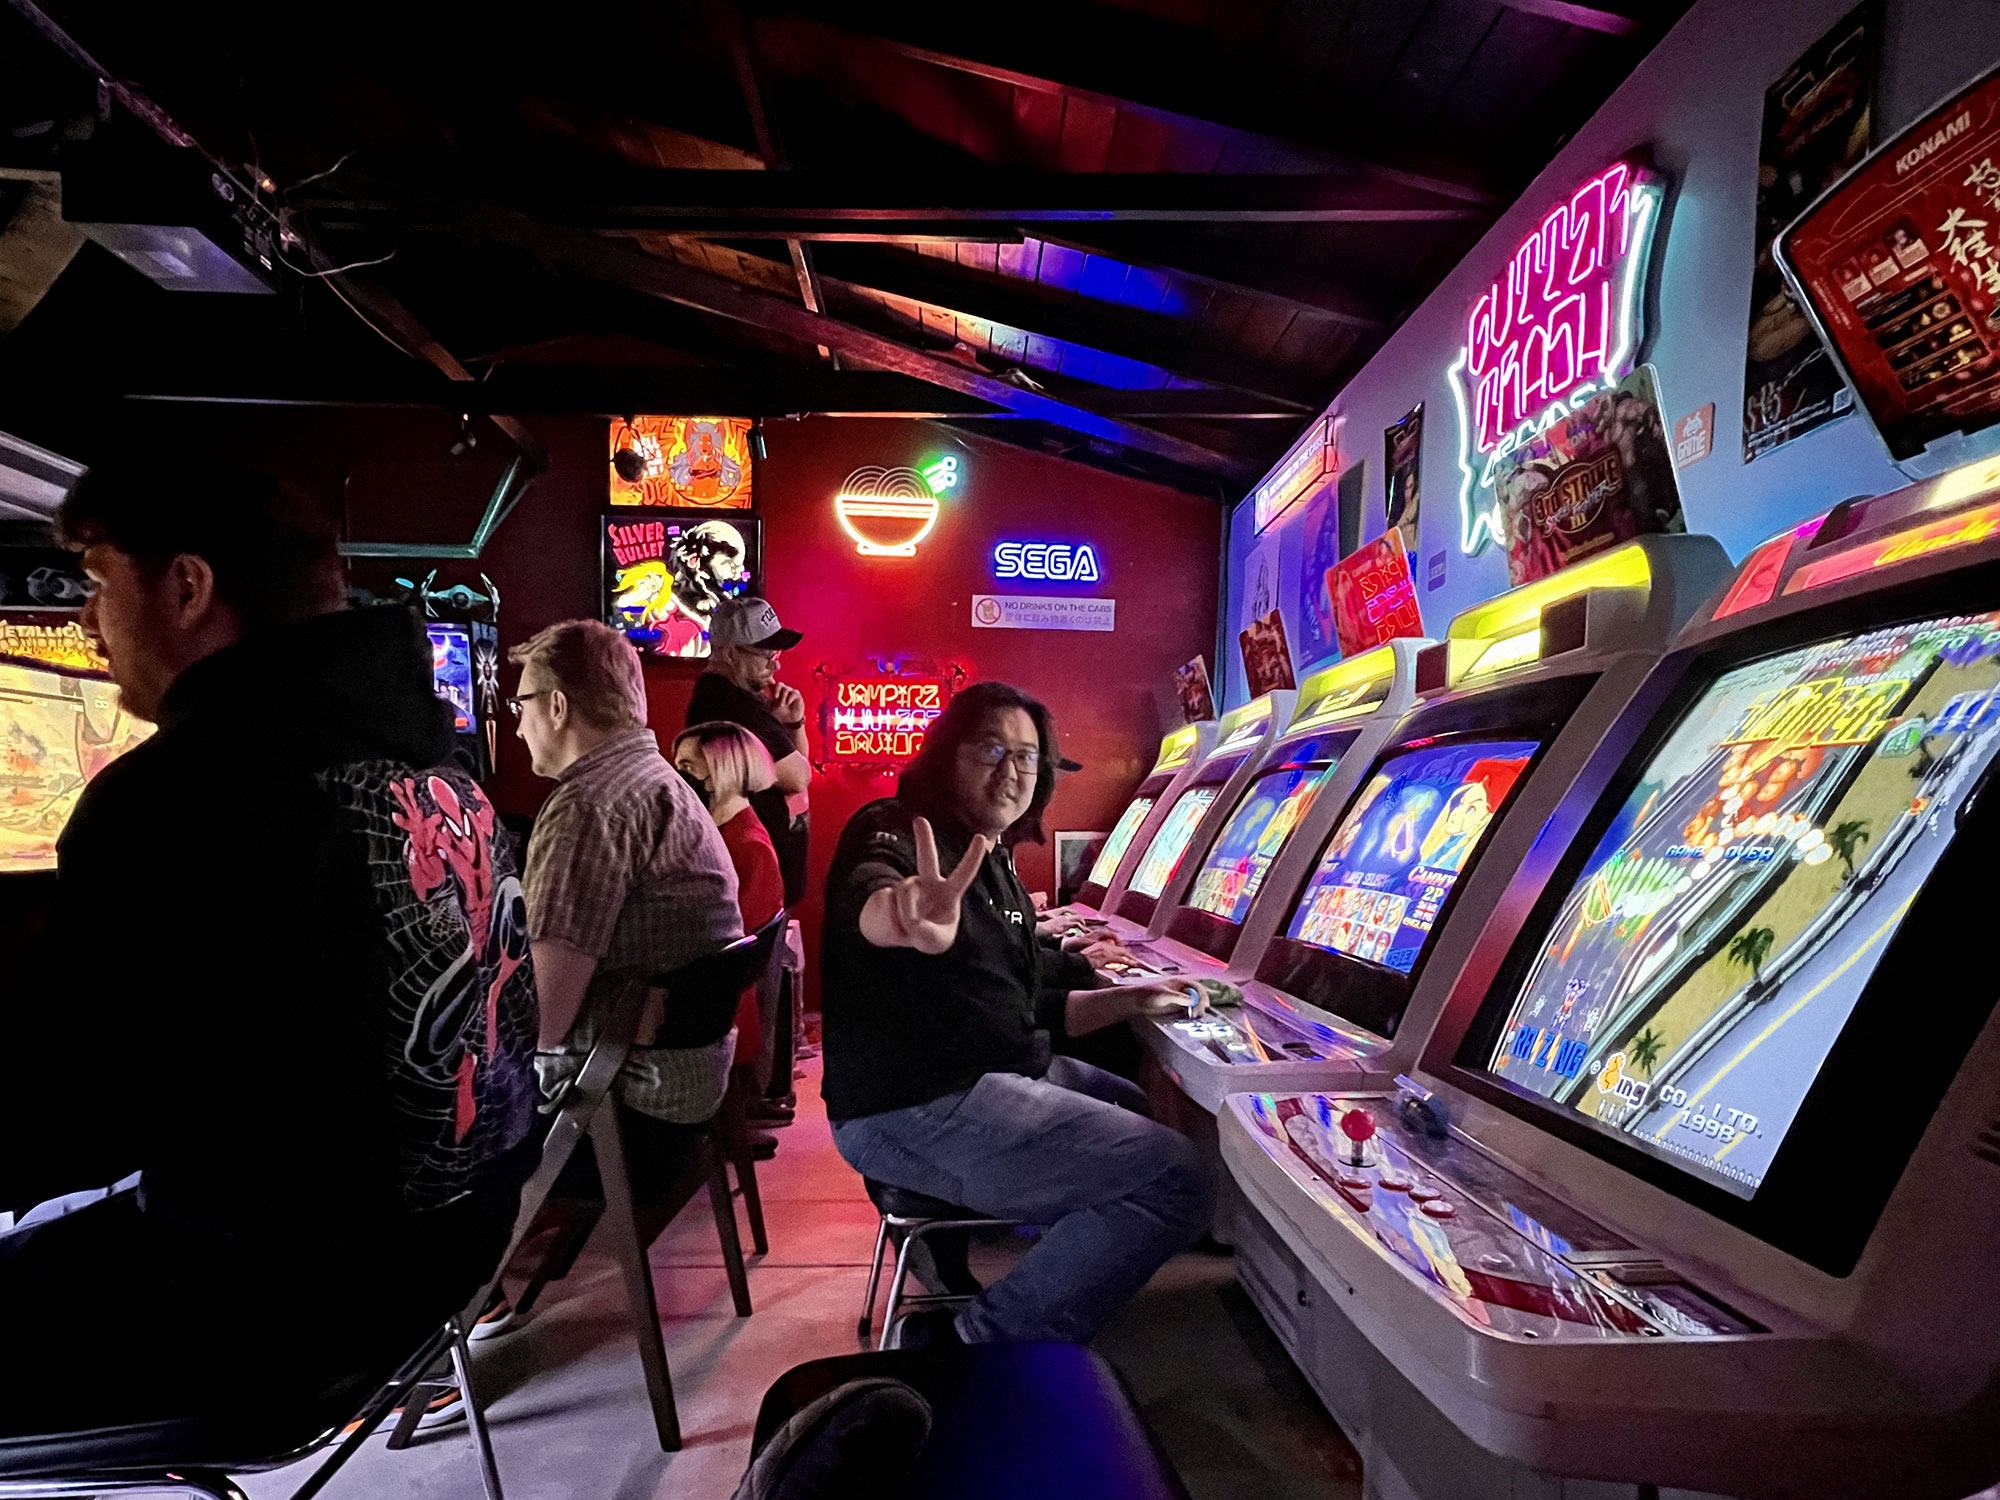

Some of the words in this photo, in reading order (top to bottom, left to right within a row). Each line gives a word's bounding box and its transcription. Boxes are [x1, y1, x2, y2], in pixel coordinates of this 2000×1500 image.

[1896, 111, 1970, 174] KONAMI
[1468, 164, 1629, 376] GUTTER
[1476, 281, 1609, 453] TRASH
[608, 522, 664, 546] SILVER
[613, 541, 665, 566] BULLET
[995, 542, 1098, 581] SEGA
[1005, 602, 1018, 610] NO
[1020, 602, 1052, 611] DRINKS
[1054, 603, 1067, 611] ON
[1070, 604, 1086, 612] THE
[1088, 604, 1112, 613] CABS
[1665, 844, 1704, 858] GAME
[1724, 846, 1775, 861] OVER
[1421, 885, 1445, 903] 2P
[1511, 1025, 1588, 1080] RAIZING
[1678, 1110, 1736, 1144] 1998
